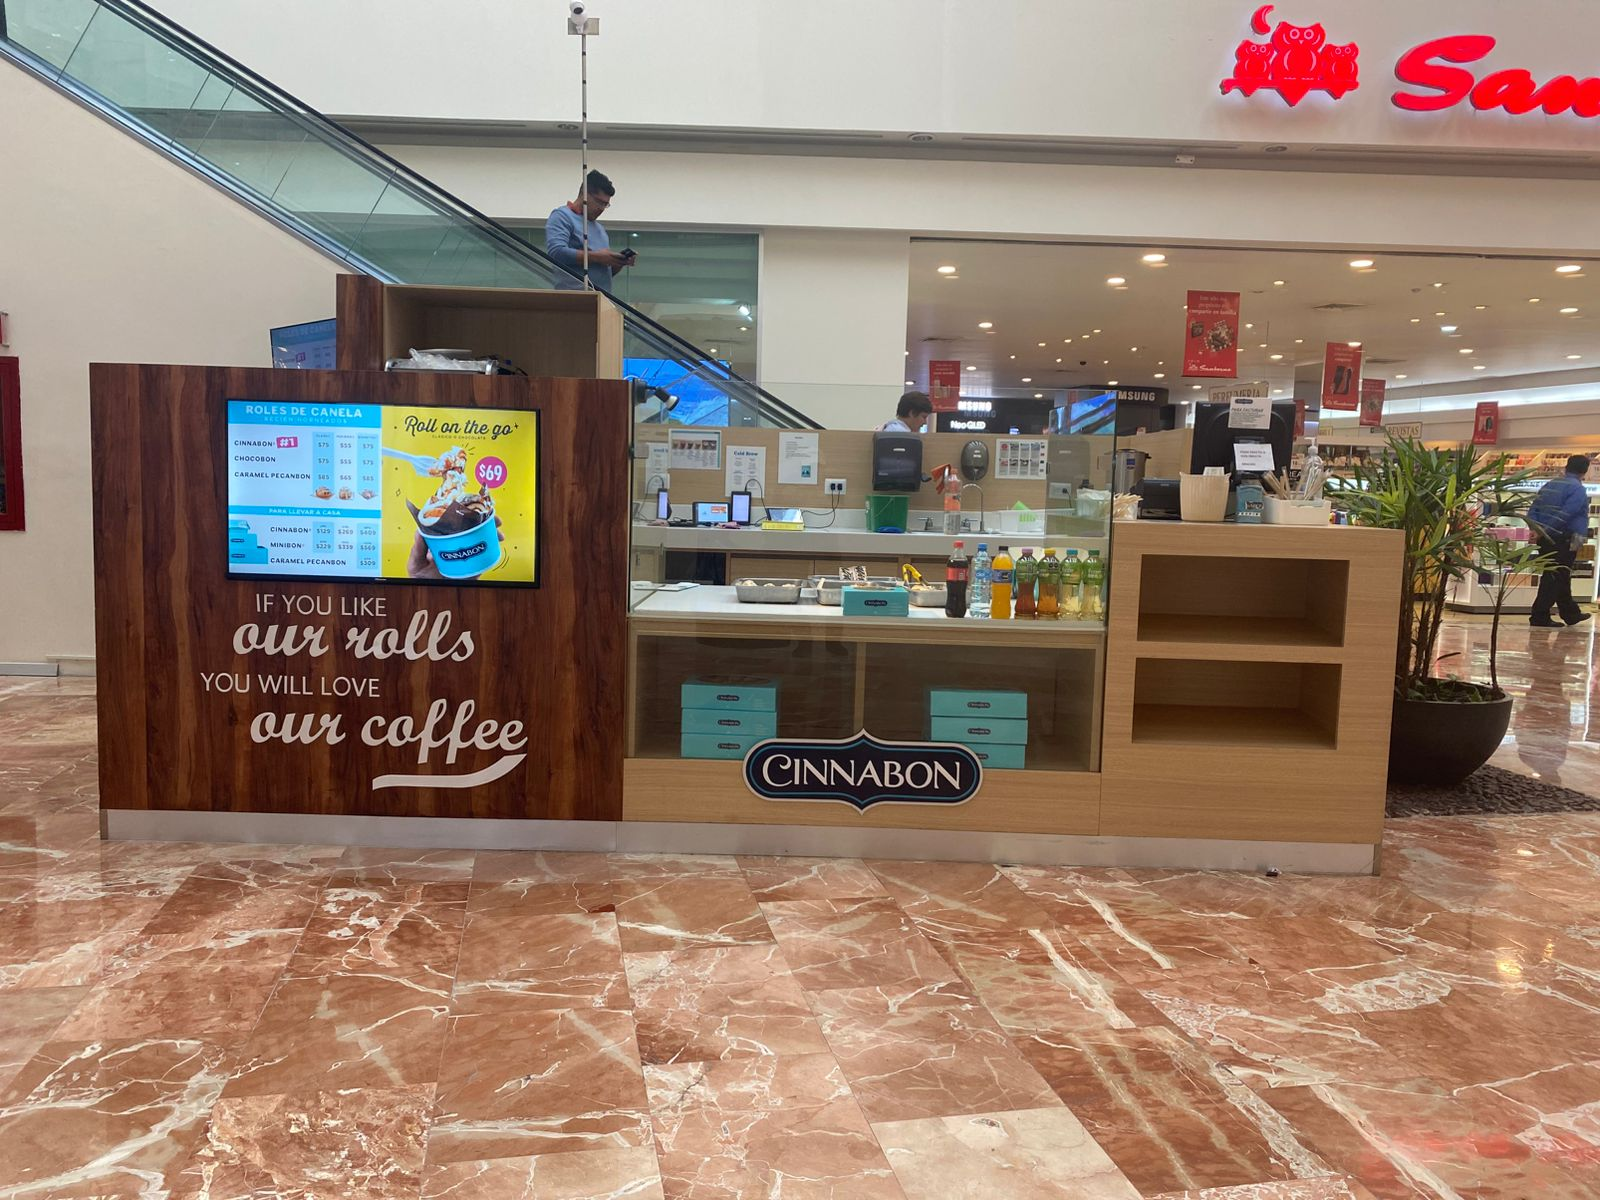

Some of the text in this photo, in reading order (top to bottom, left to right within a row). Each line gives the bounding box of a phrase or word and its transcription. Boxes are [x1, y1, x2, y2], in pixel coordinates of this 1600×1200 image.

[246, 405, 363, 418] ROLES DE CANELA
[404, 415, 514, 440] Roll on the go
[279, 437, 296, 447] #1
[234, 455, 276, 463] CHOCOBON
[234, 471, 311, 480] CARAMEL PECANBON
[479, 464, 503, 481] $69
[441, 543, 485, 561] CINNABON
[270, 557, 347, 566] CARAMEL PECANBON
[255, 593, 387, 617] IF YOU LIKE
[232, 609, 475, 662] our rolls
[200, 672, 381, 698] YOU WILL LOVE
[250, 698, 529, 765] our coffee
[762, 754, 961, 790] CINNABON
